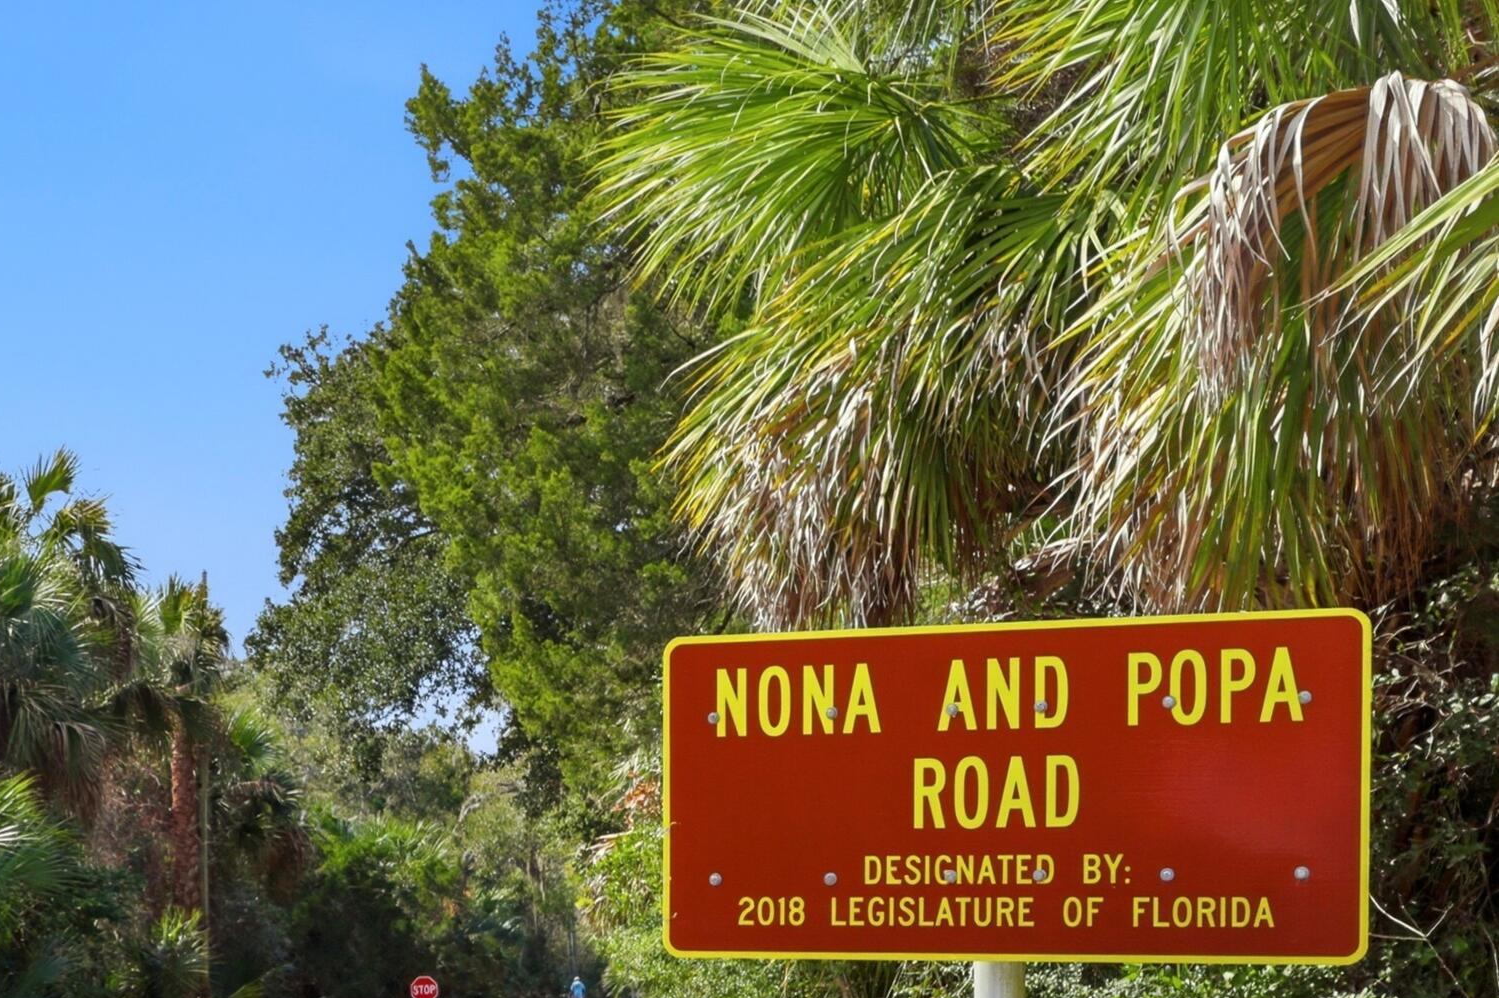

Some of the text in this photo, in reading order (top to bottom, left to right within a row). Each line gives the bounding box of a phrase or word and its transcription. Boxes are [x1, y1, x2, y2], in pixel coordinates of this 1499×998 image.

[715, 647, 1305, 738] NONA AND POPA
[913, 754, 1080, 829] ROAD
[864, 853, 1132, 886] DESIGNATED BY:
[738, 896, 1275, 928] 2018 LEGISLATURE OF FLORIDA
[413, 984, 436, 996] STOP
